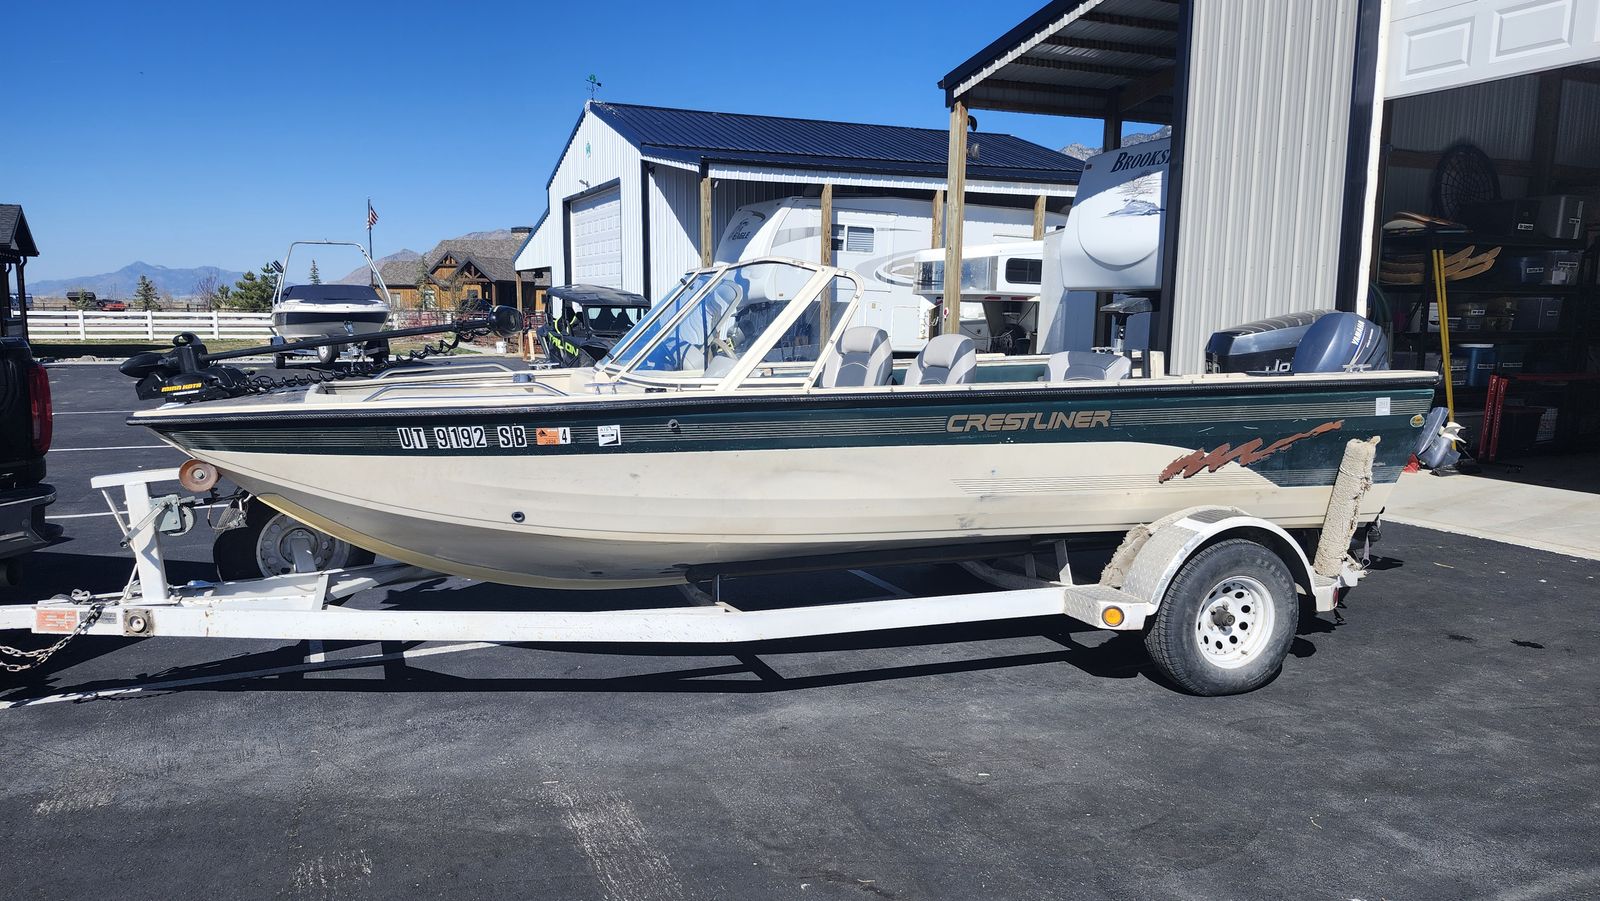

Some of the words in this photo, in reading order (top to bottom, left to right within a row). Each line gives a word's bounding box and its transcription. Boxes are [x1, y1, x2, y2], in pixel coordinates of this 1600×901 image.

[1352, 320, 1366, 345] YAMAHA
[548, 332, 579, 357] TALON
[946, 410, 1112, 432] CRESTLINER
[398, 428, 428, 448] UT
[434, 427, 487, 448] 9192
[499, 426, 527, 448] SB
